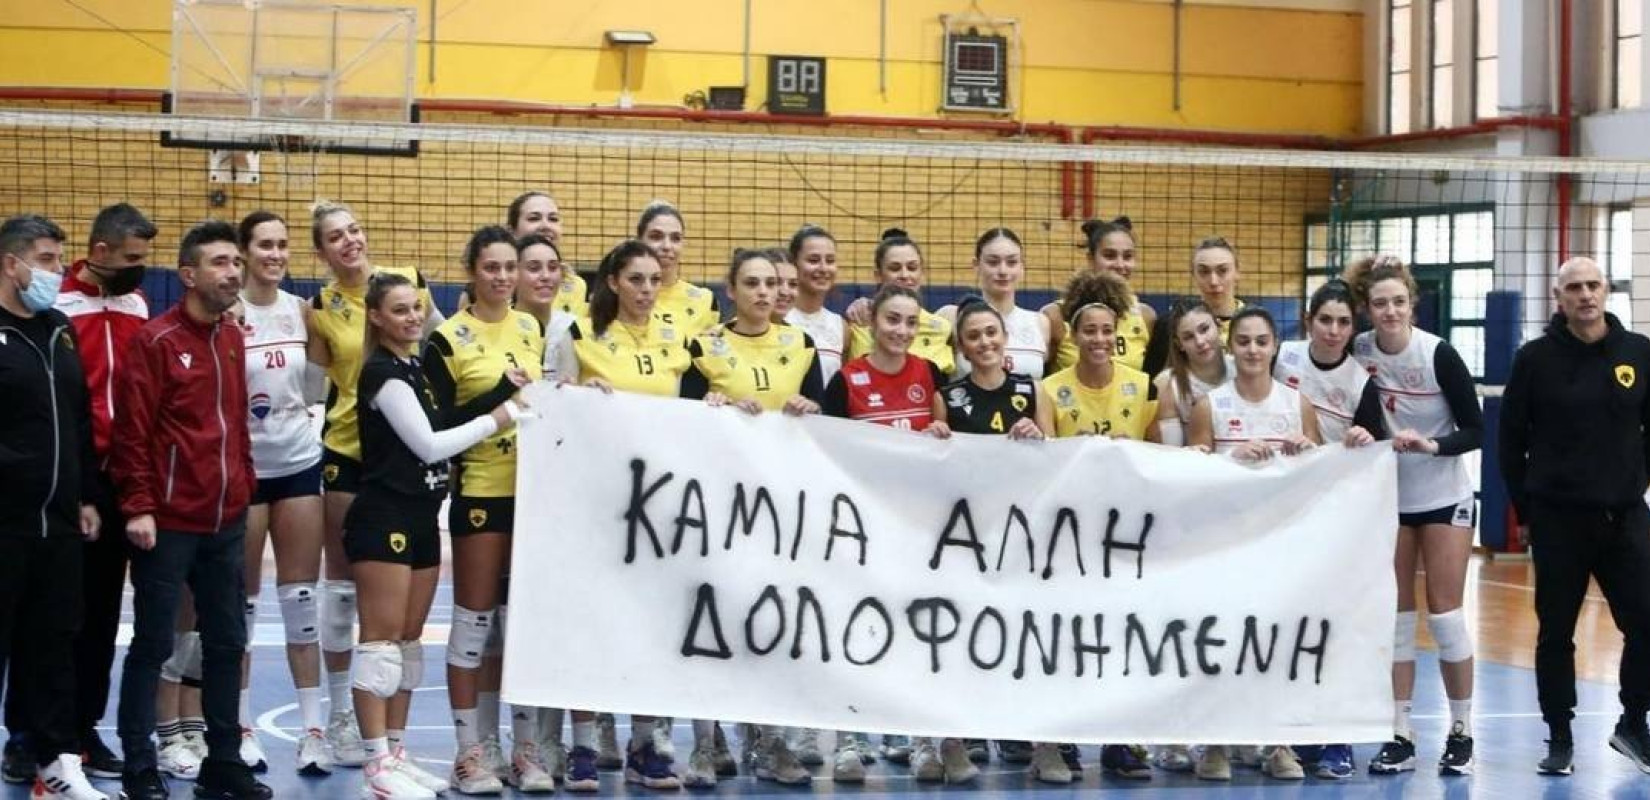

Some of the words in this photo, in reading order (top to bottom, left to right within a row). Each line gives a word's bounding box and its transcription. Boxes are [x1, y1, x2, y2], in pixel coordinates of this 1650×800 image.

[264, 350, 286, 369] 20
[634, 354, 654, 375] 13
[751, 367, 771, 390] 11
[990, 410, 1004, 433] 4
[623, 458, 869, 566] ΚΑΜΙΑ
[929, 498, 1155, 581] ΑΛΛΗ
[680, 582, 1332, 685] ΔΟΛΟΦΟΝΗΜΕΝΗ
